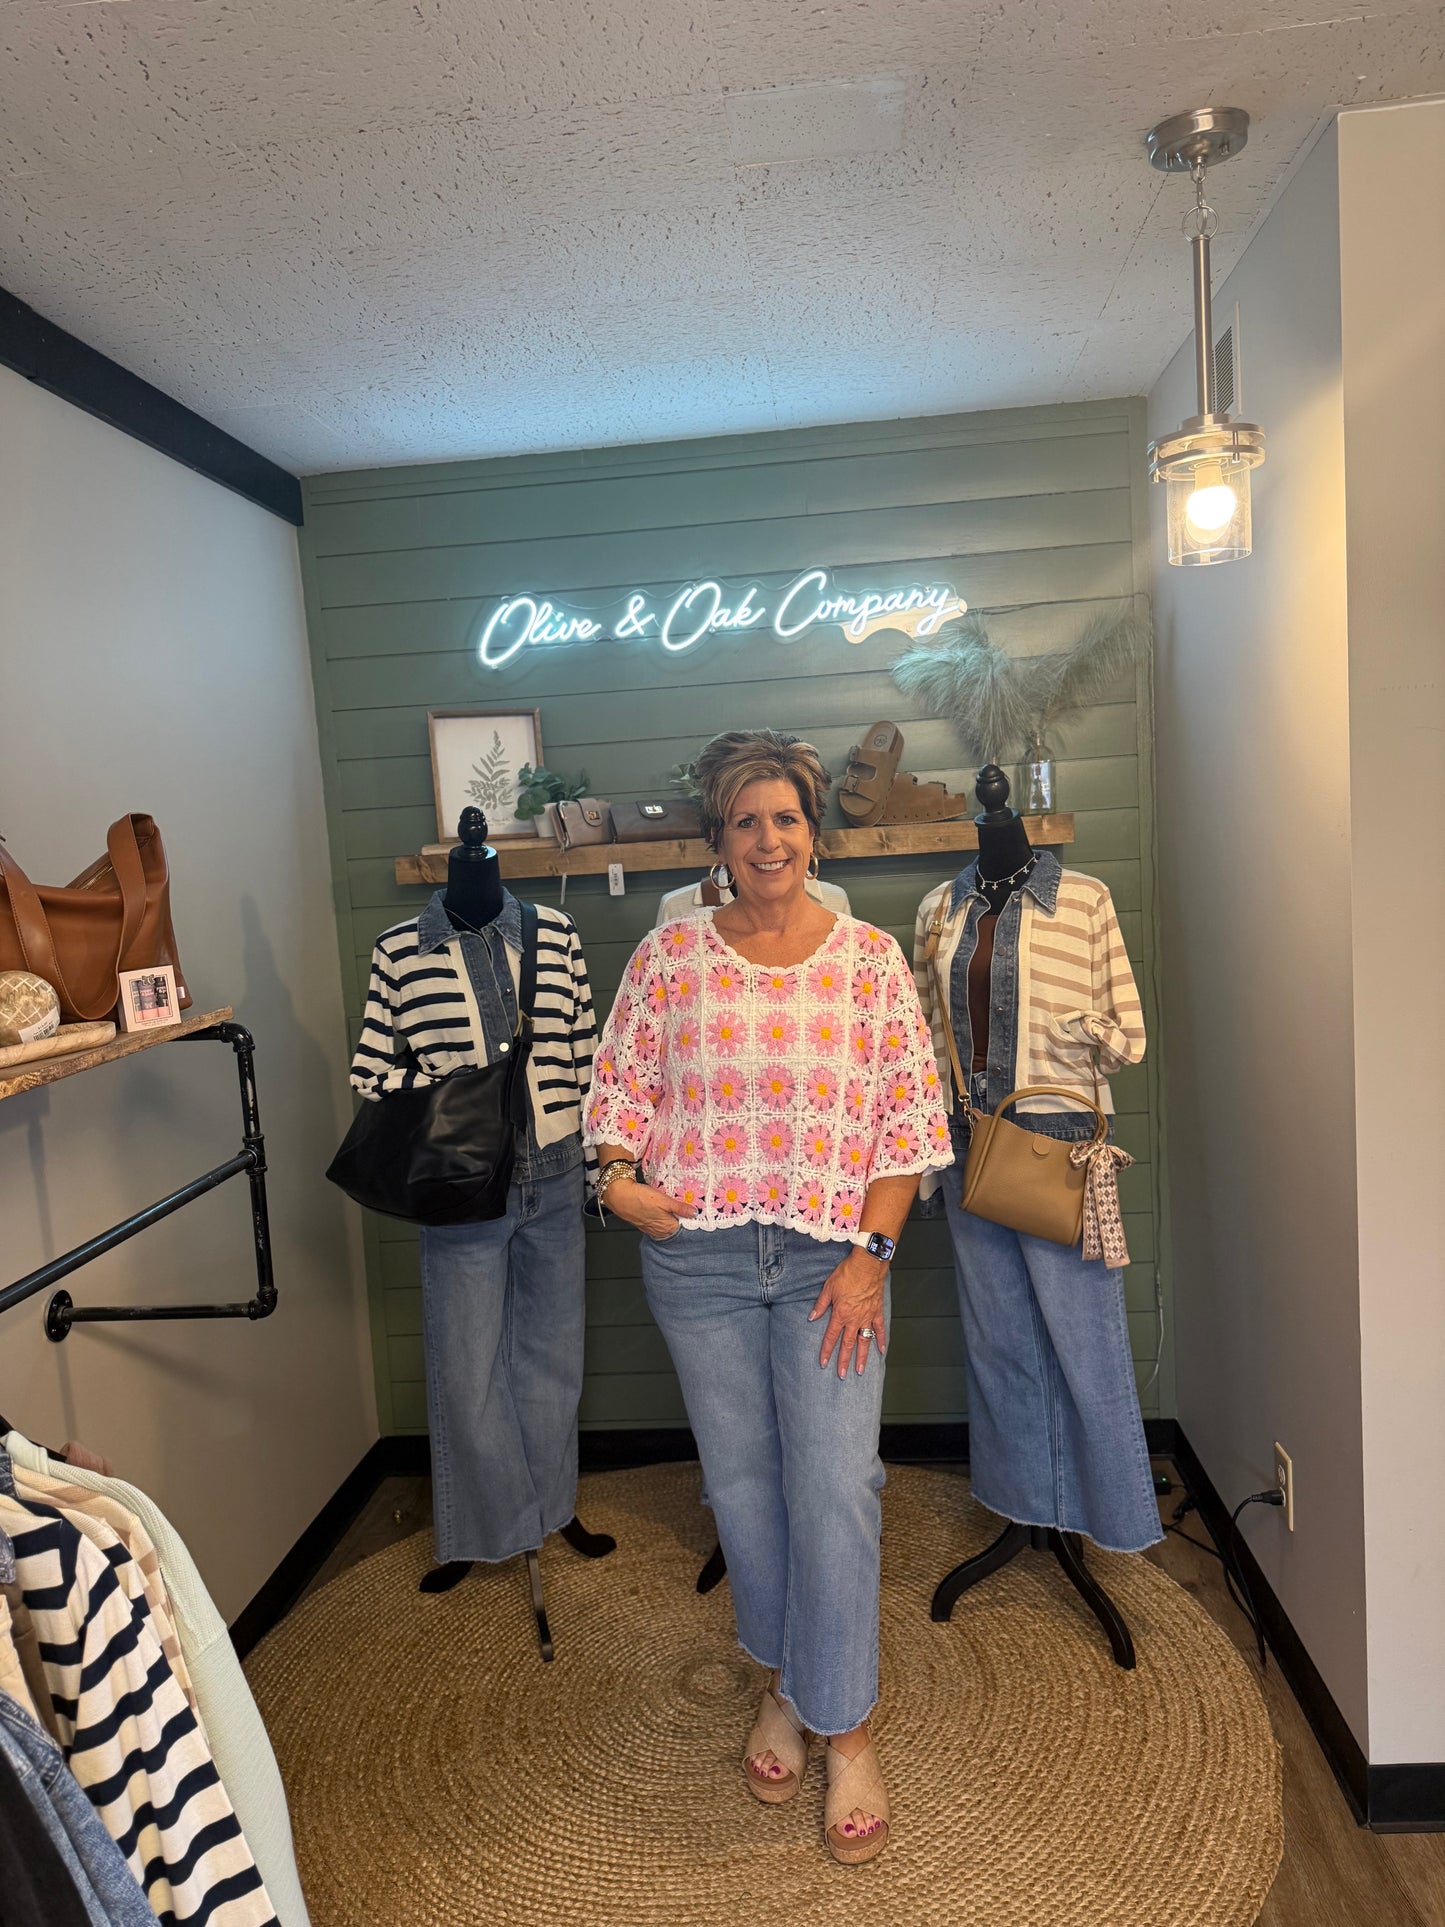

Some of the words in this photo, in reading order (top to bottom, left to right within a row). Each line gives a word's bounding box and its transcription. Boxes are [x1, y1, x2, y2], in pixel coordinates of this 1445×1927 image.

[480, 597, 602, 666] Olive
[615, 595, 655, 638] &
[662, 582, 766, 651] Oak
[774, 571, 961, 638] Company
